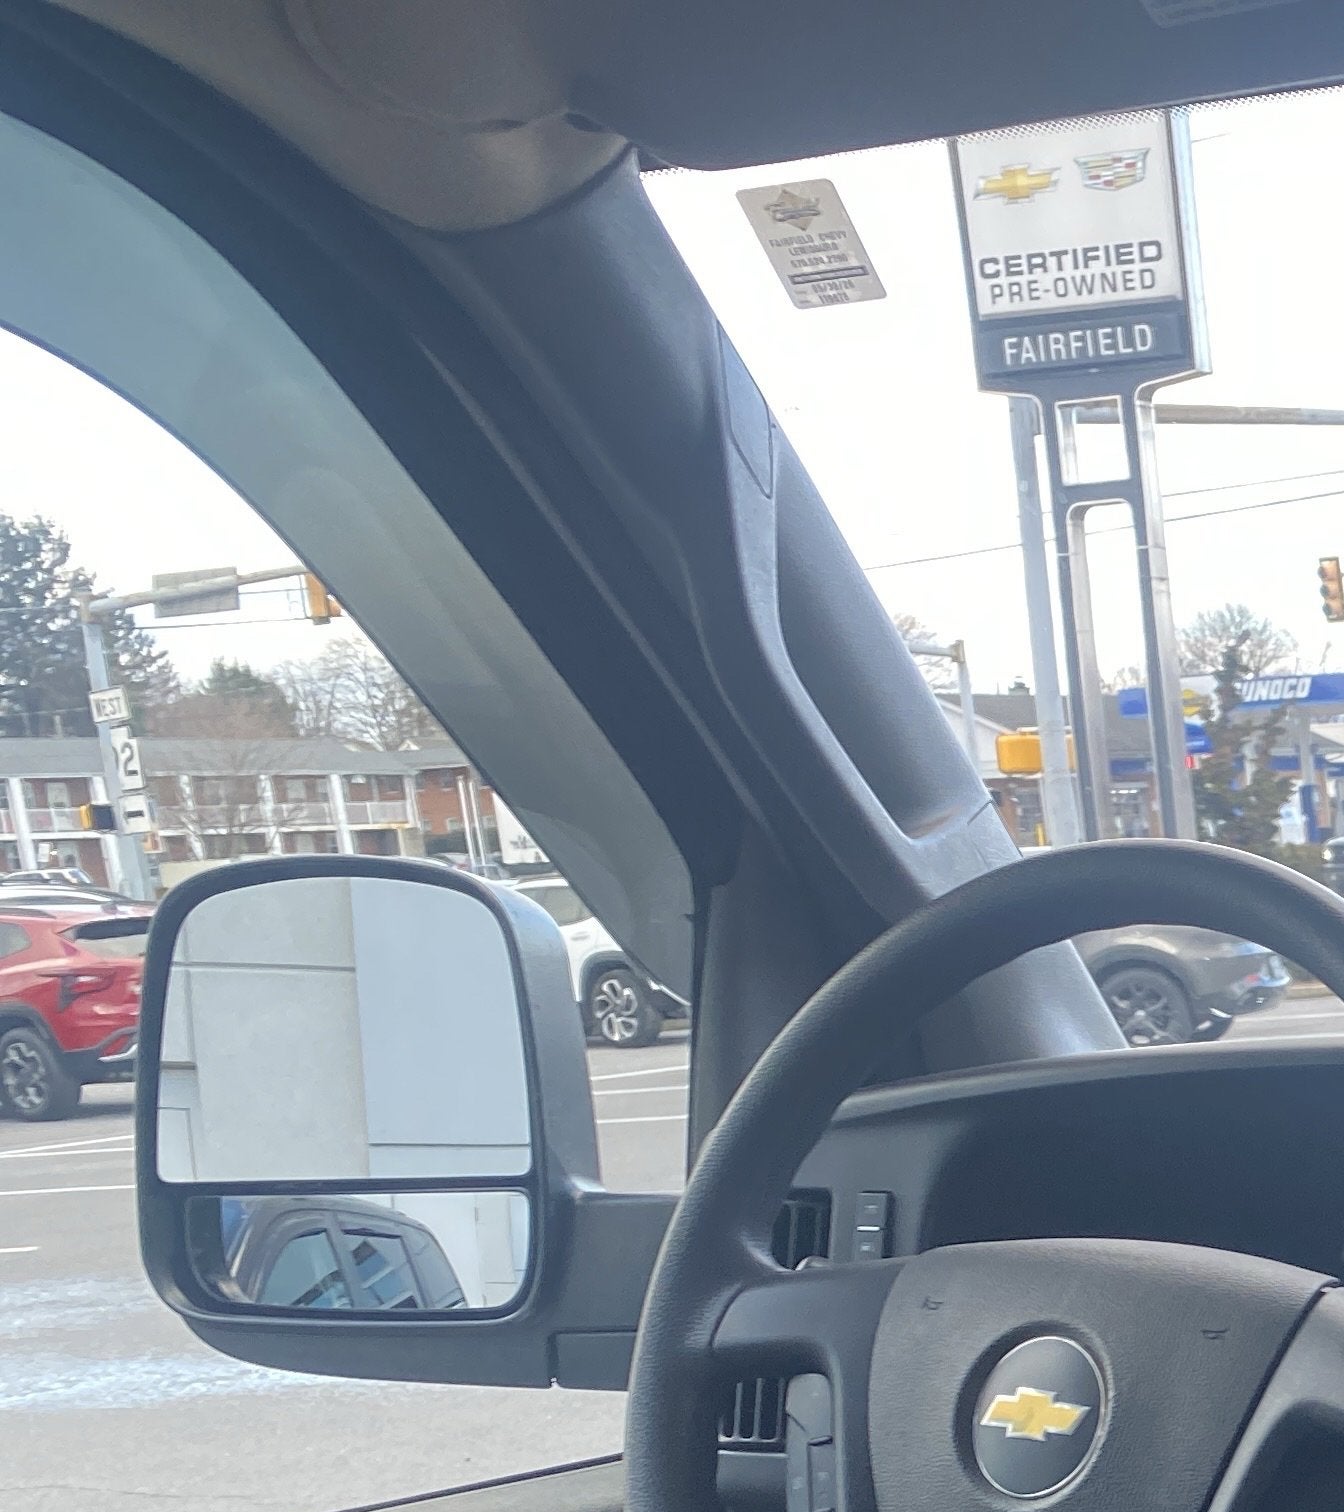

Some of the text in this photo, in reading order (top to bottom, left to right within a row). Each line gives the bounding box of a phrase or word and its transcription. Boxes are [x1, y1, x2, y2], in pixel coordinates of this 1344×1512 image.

[978, 239, 1163, 280] CERTIFIED
[990, 268, 1156, 305] PRE-OWNED
[1003, 322, 1153, 366] FAIRFIELD
[1234, 677, 1312, 702] UNOCO
